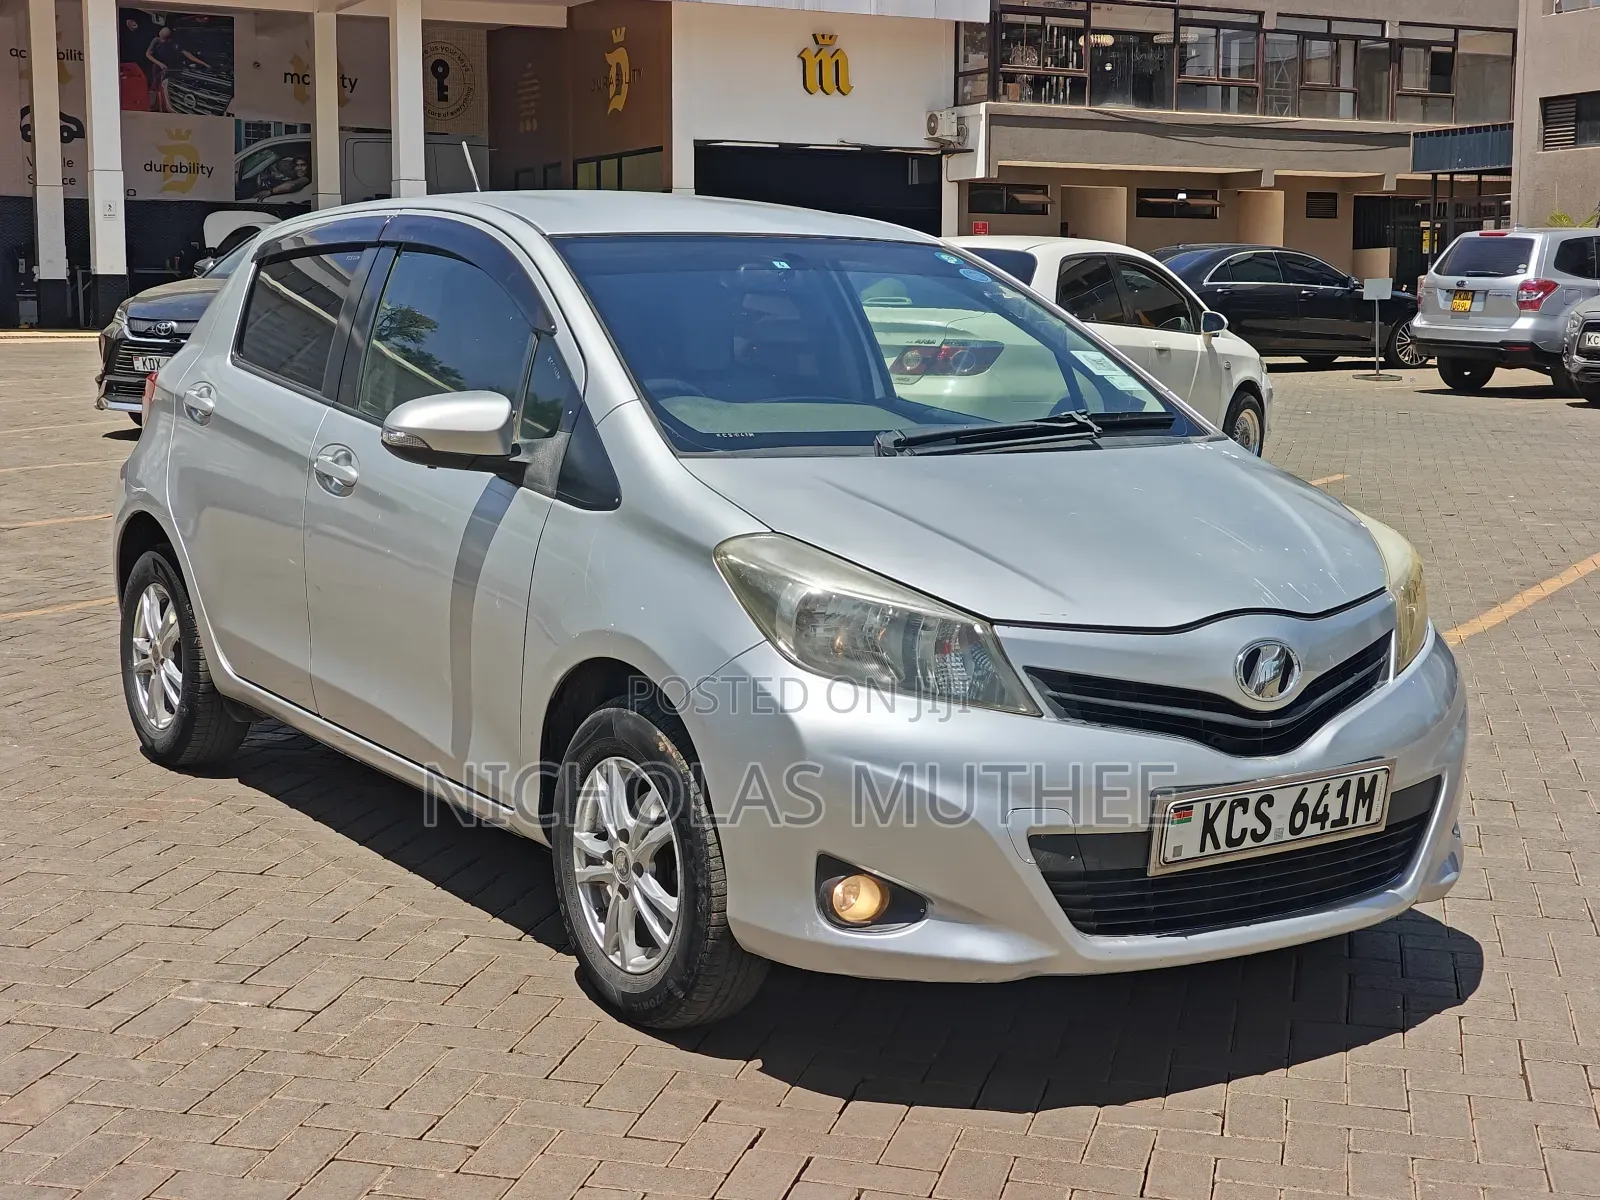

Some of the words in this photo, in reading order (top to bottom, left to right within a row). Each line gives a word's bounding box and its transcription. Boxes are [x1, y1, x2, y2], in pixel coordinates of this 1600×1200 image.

[9, 47, 84, 61] acbilit
[143, 160, 214, 179] durability
[142, 357, 161, 371] KDX
[1199, 793, 1275, 853] KCS
[1288, 773, 1379, 837] 641M
